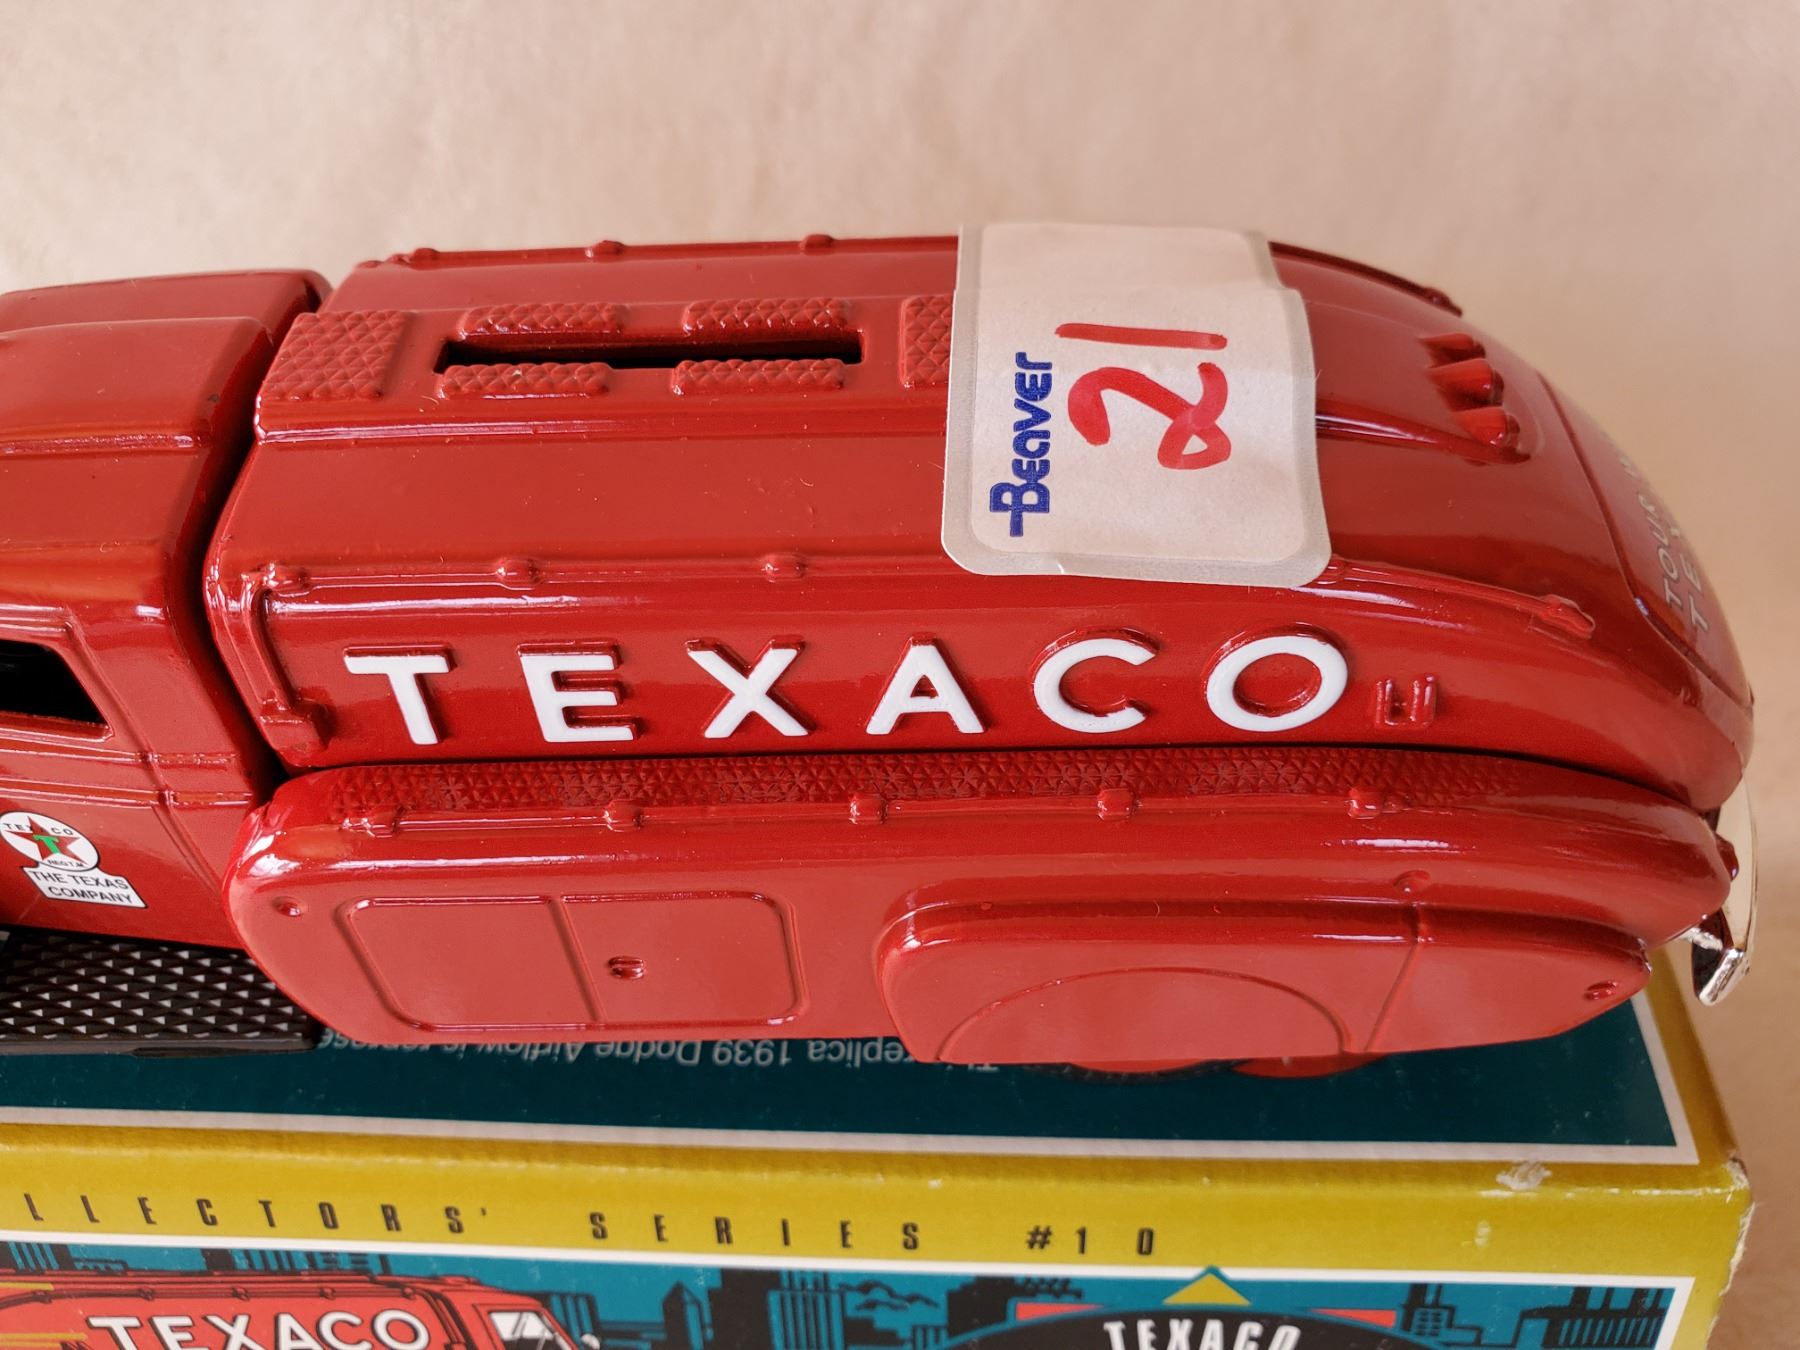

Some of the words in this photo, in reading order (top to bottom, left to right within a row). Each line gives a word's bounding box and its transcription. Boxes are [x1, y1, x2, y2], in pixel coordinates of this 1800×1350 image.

[1055, 322, 1232, 470] 21
[343, 630, 1350, 746] TEXACO
[29, 870, 68, 884] THE
[68, 873, 129, 890] TEXAS
[48, 886, 133, 904] COMPANY
[596, 1040, 701, 1066] Dodge
[712, 1038, 792, 1067] 1939
[589, 1211, 920, 1251] SERIES
[88, 1308, 430, 1350] TEXACO
[1103, 1317, 1301, 1350] TEXACO
